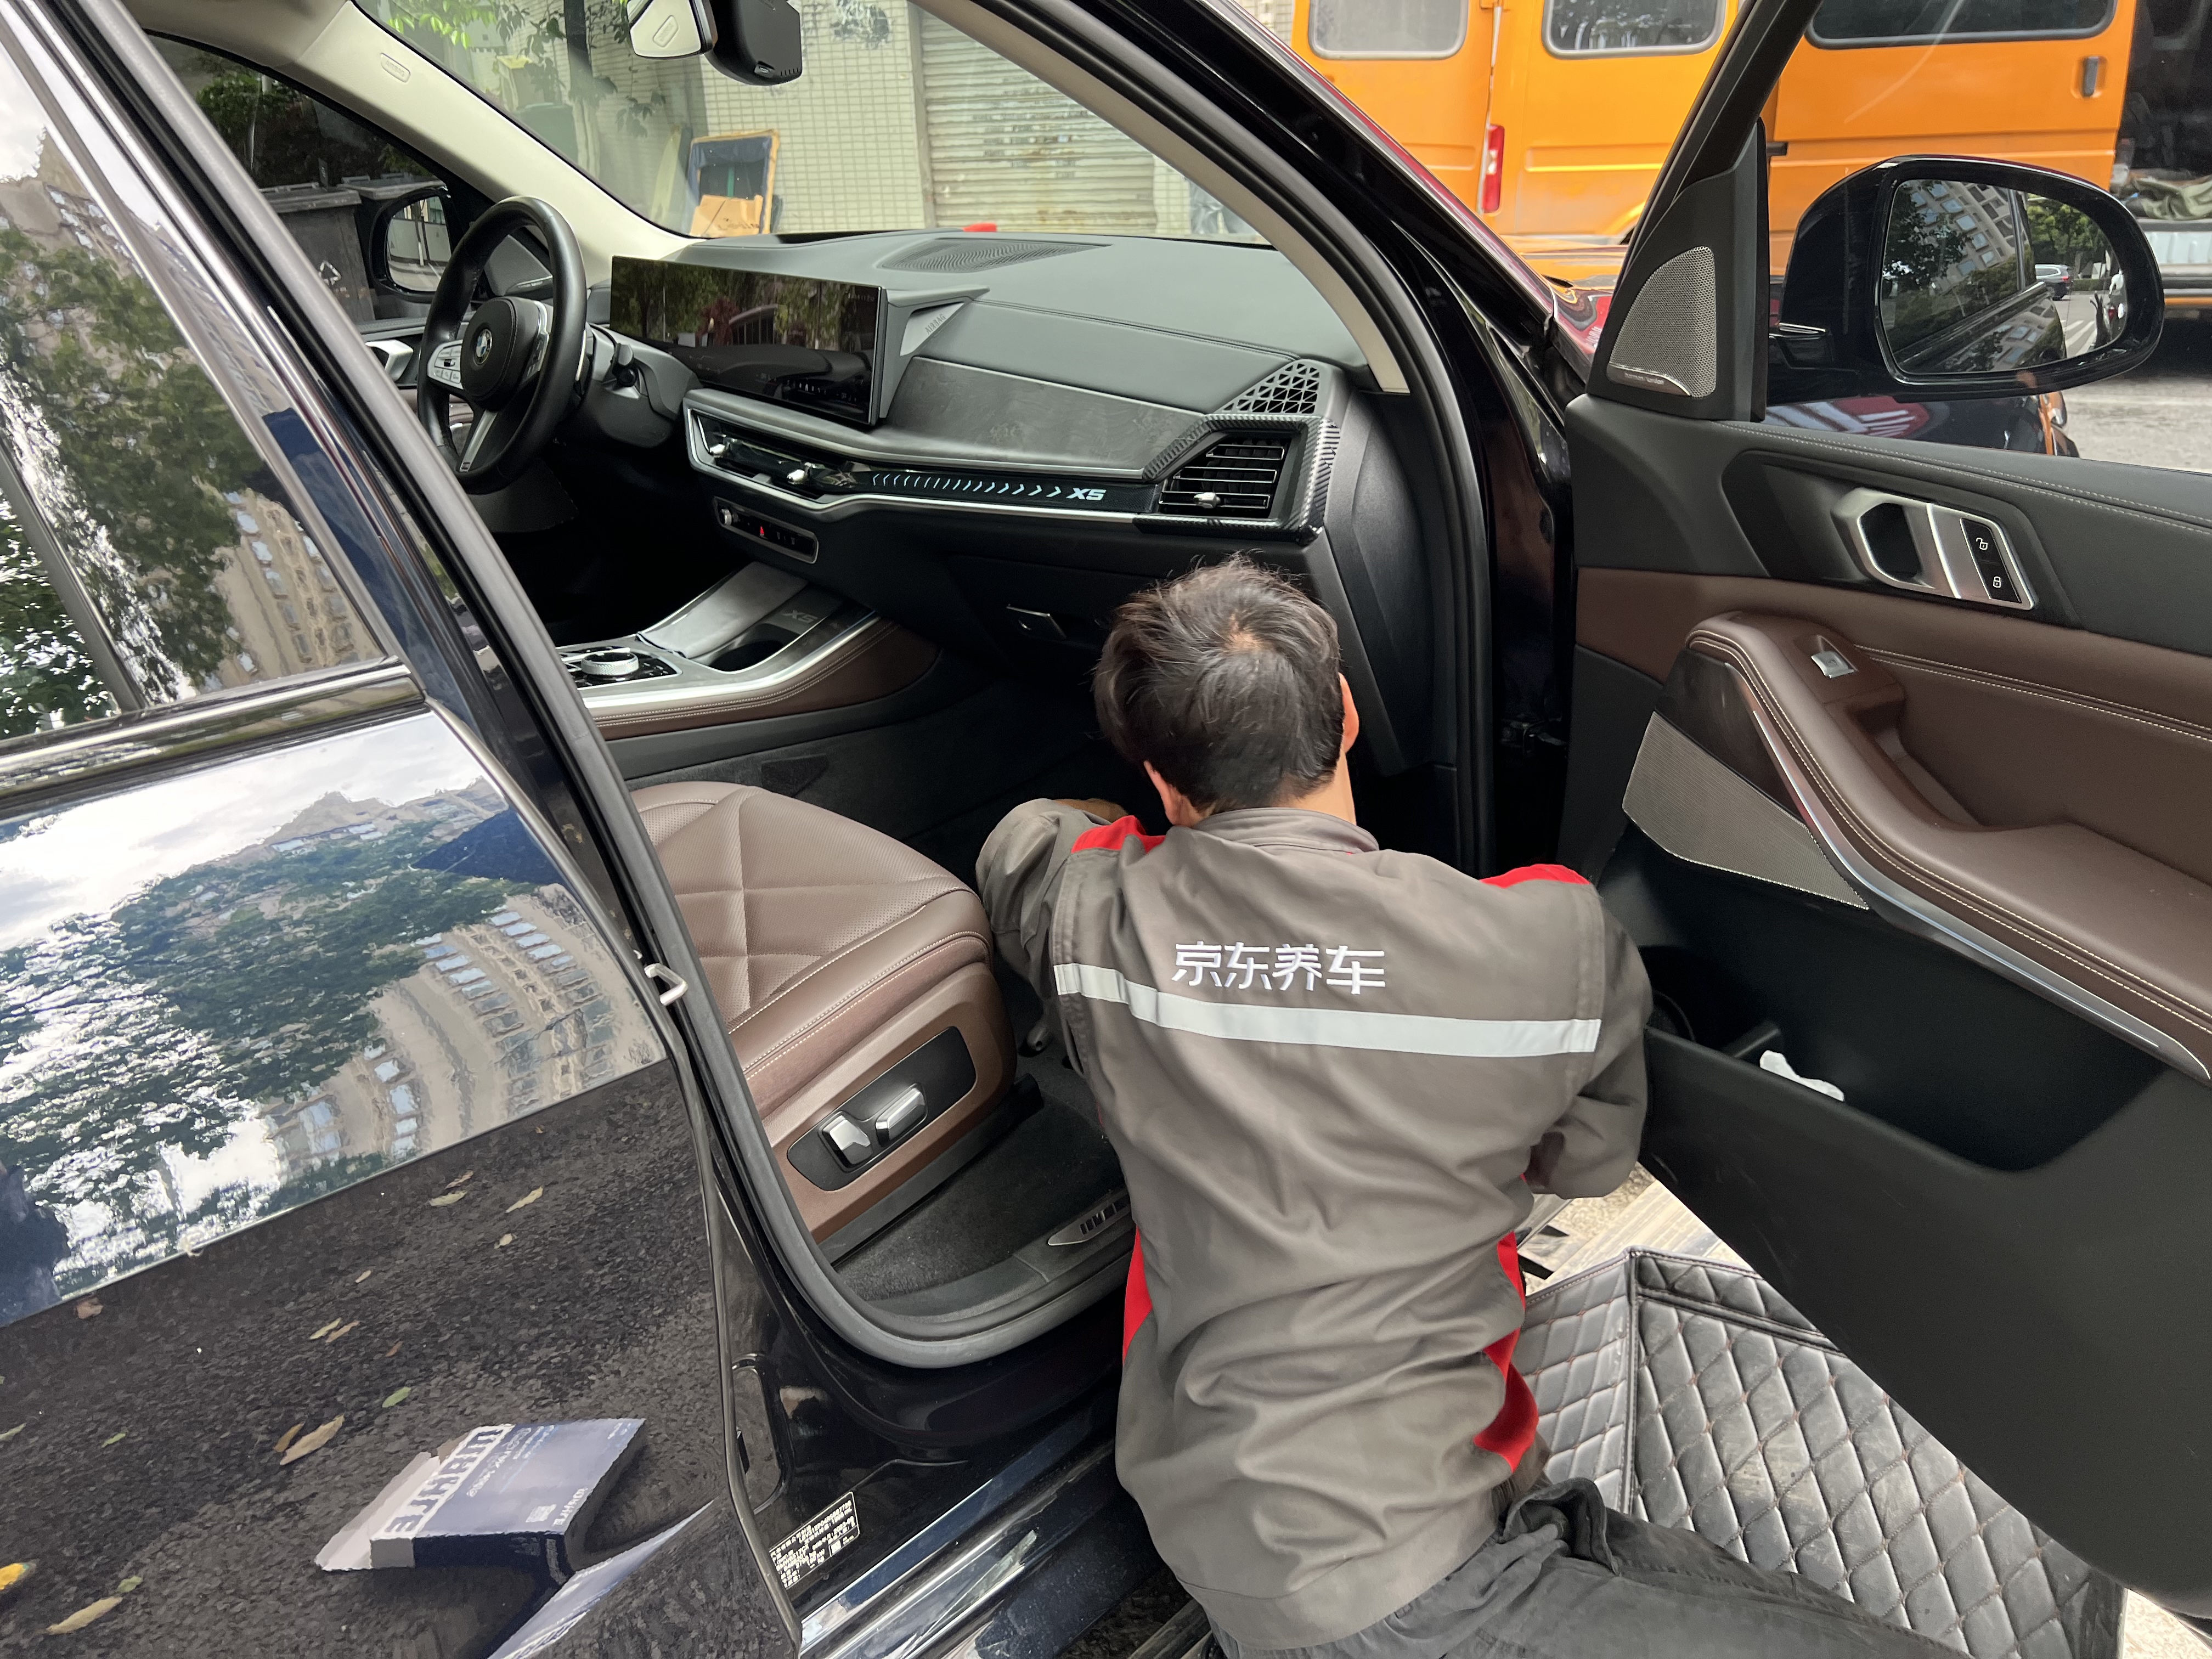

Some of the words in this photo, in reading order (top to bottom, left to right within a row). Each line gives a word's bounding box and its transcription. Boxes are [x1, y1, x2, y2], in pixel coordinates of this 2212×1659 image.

[924, 314, 946, 335] AIRBAG
[1066, 488, 1107, 501] X5
[781, 610, 818, 623] X5
[1171, 941, 1386, 995] 京东养车
